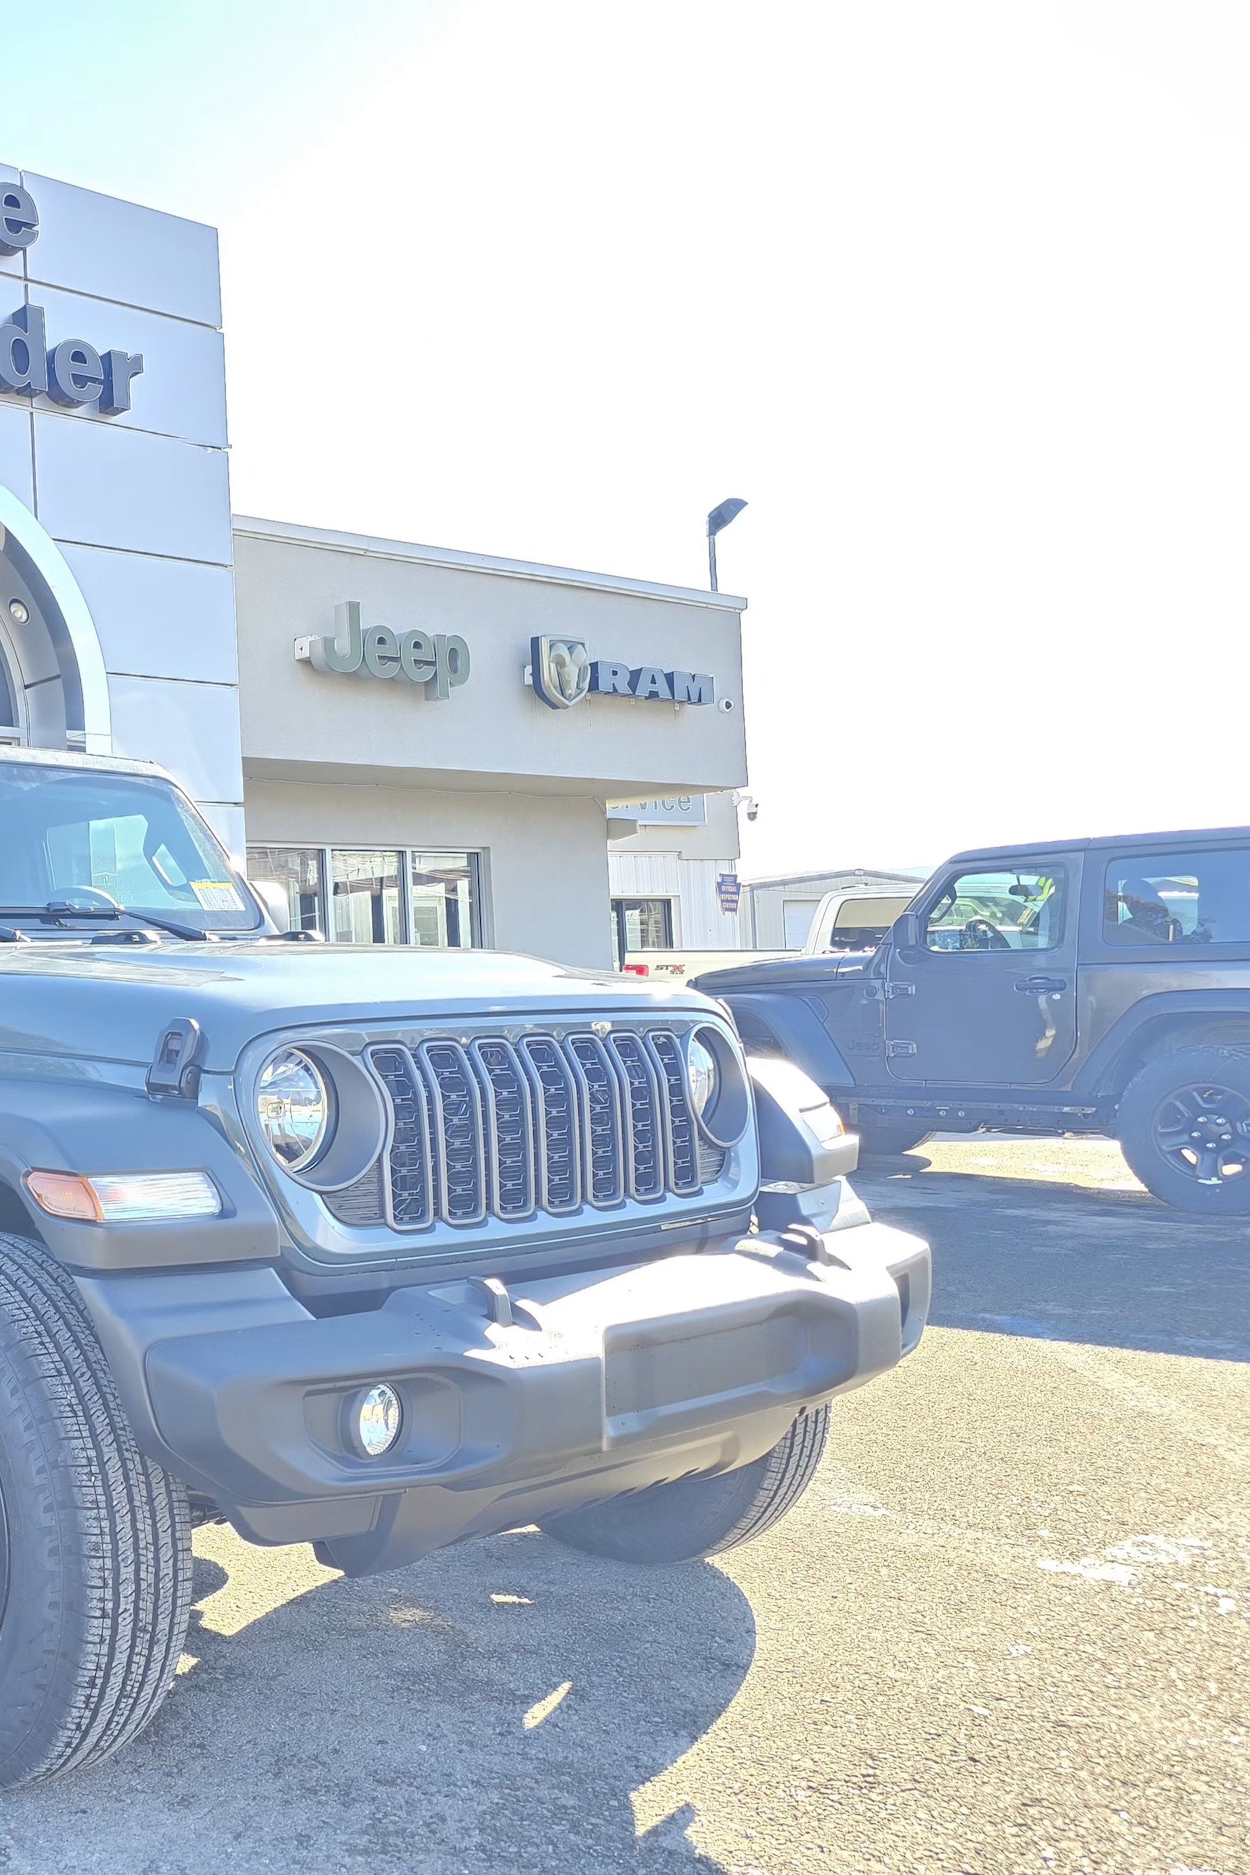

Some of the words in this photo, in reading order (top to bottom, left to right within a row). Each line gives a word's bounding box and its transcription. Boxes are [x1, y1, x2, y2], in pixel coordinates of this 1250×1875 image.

[309, 600, 471, 701] Jeep
[589, 660, 715, 705] RAM
[654, 964, 686, 972] STX
